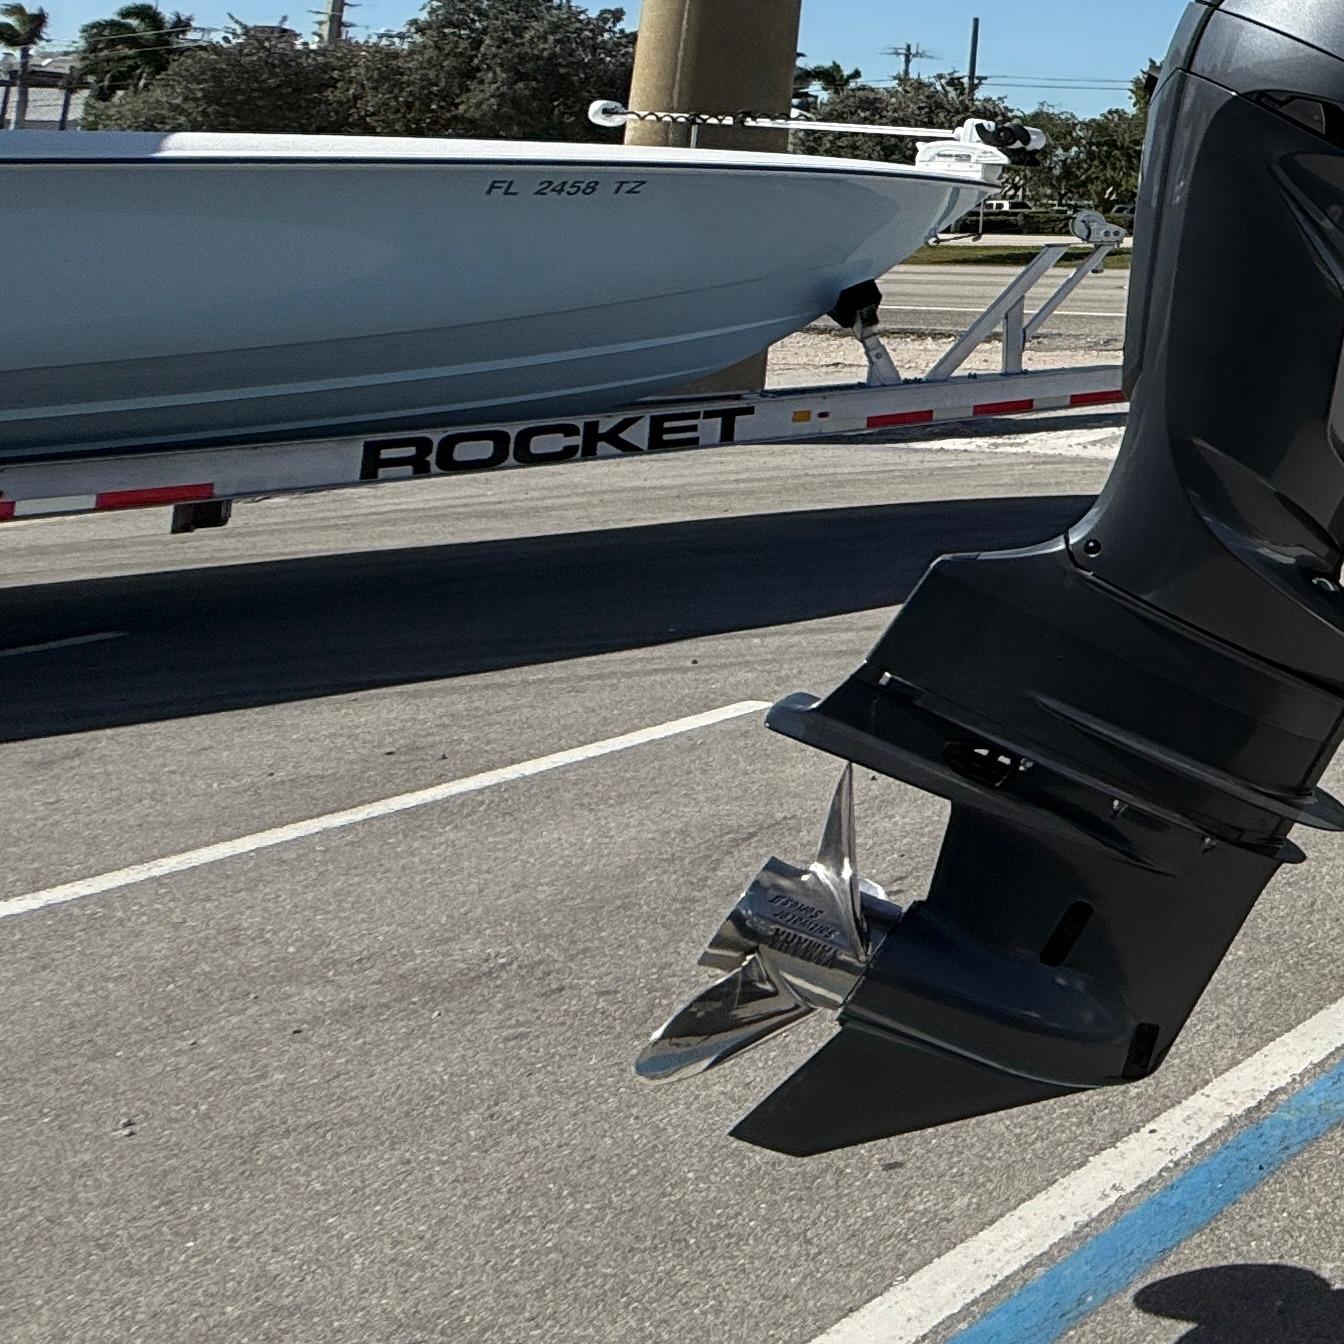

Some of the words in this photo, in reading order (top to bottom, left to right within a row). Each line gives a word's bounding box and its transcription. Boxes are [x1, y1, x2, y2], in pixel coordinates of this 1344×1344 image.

[485, 180, 519, 196] FL
[533, 180, 600, 196] 2458
[613, 180, 647, 195] TZ
[359, 405, 756, 481] ROCKET
